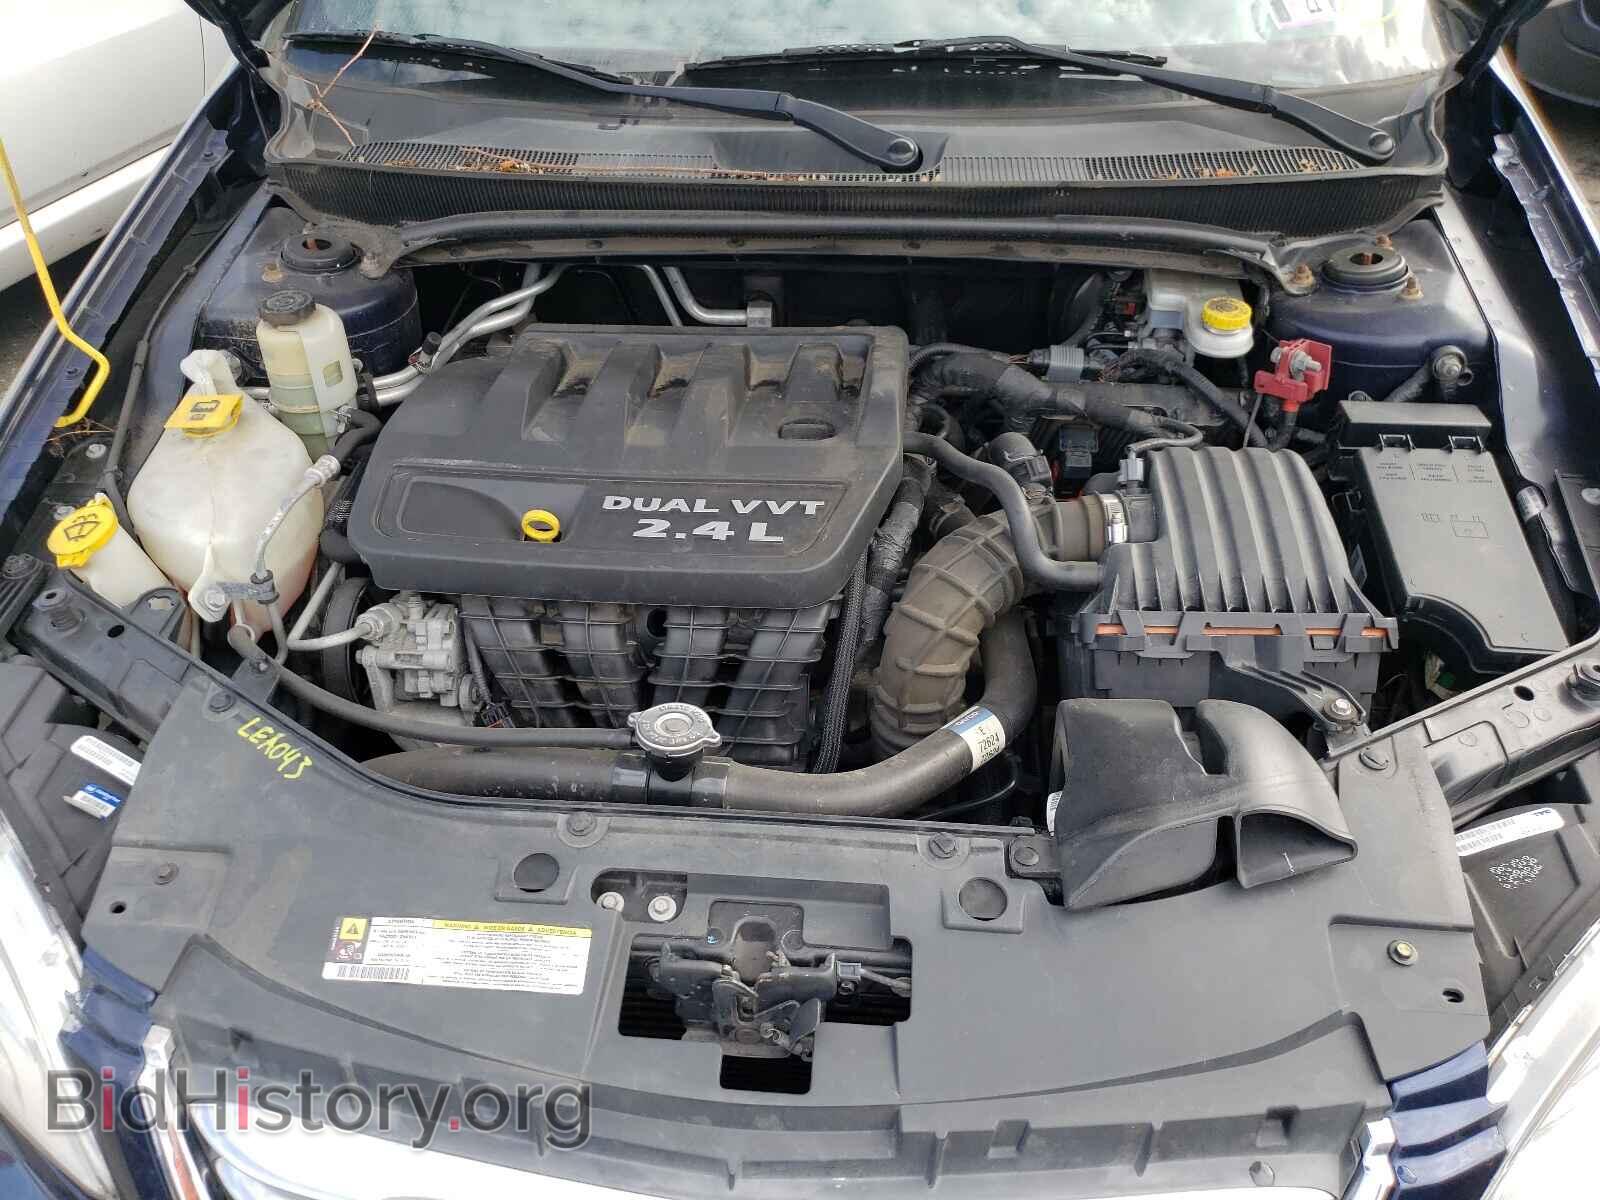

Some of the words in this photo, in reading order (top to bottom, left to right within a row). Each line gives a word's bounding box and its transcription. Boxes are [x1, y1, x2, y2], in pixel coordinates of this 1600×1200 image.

[601, 495, 720, 513] DUAL
[731, 499, 825, 514] VVT
[632, 518, 735, 541] 2.4
[749, 522, 784, 542] L
[977, 732, 1000, 753] 72624
